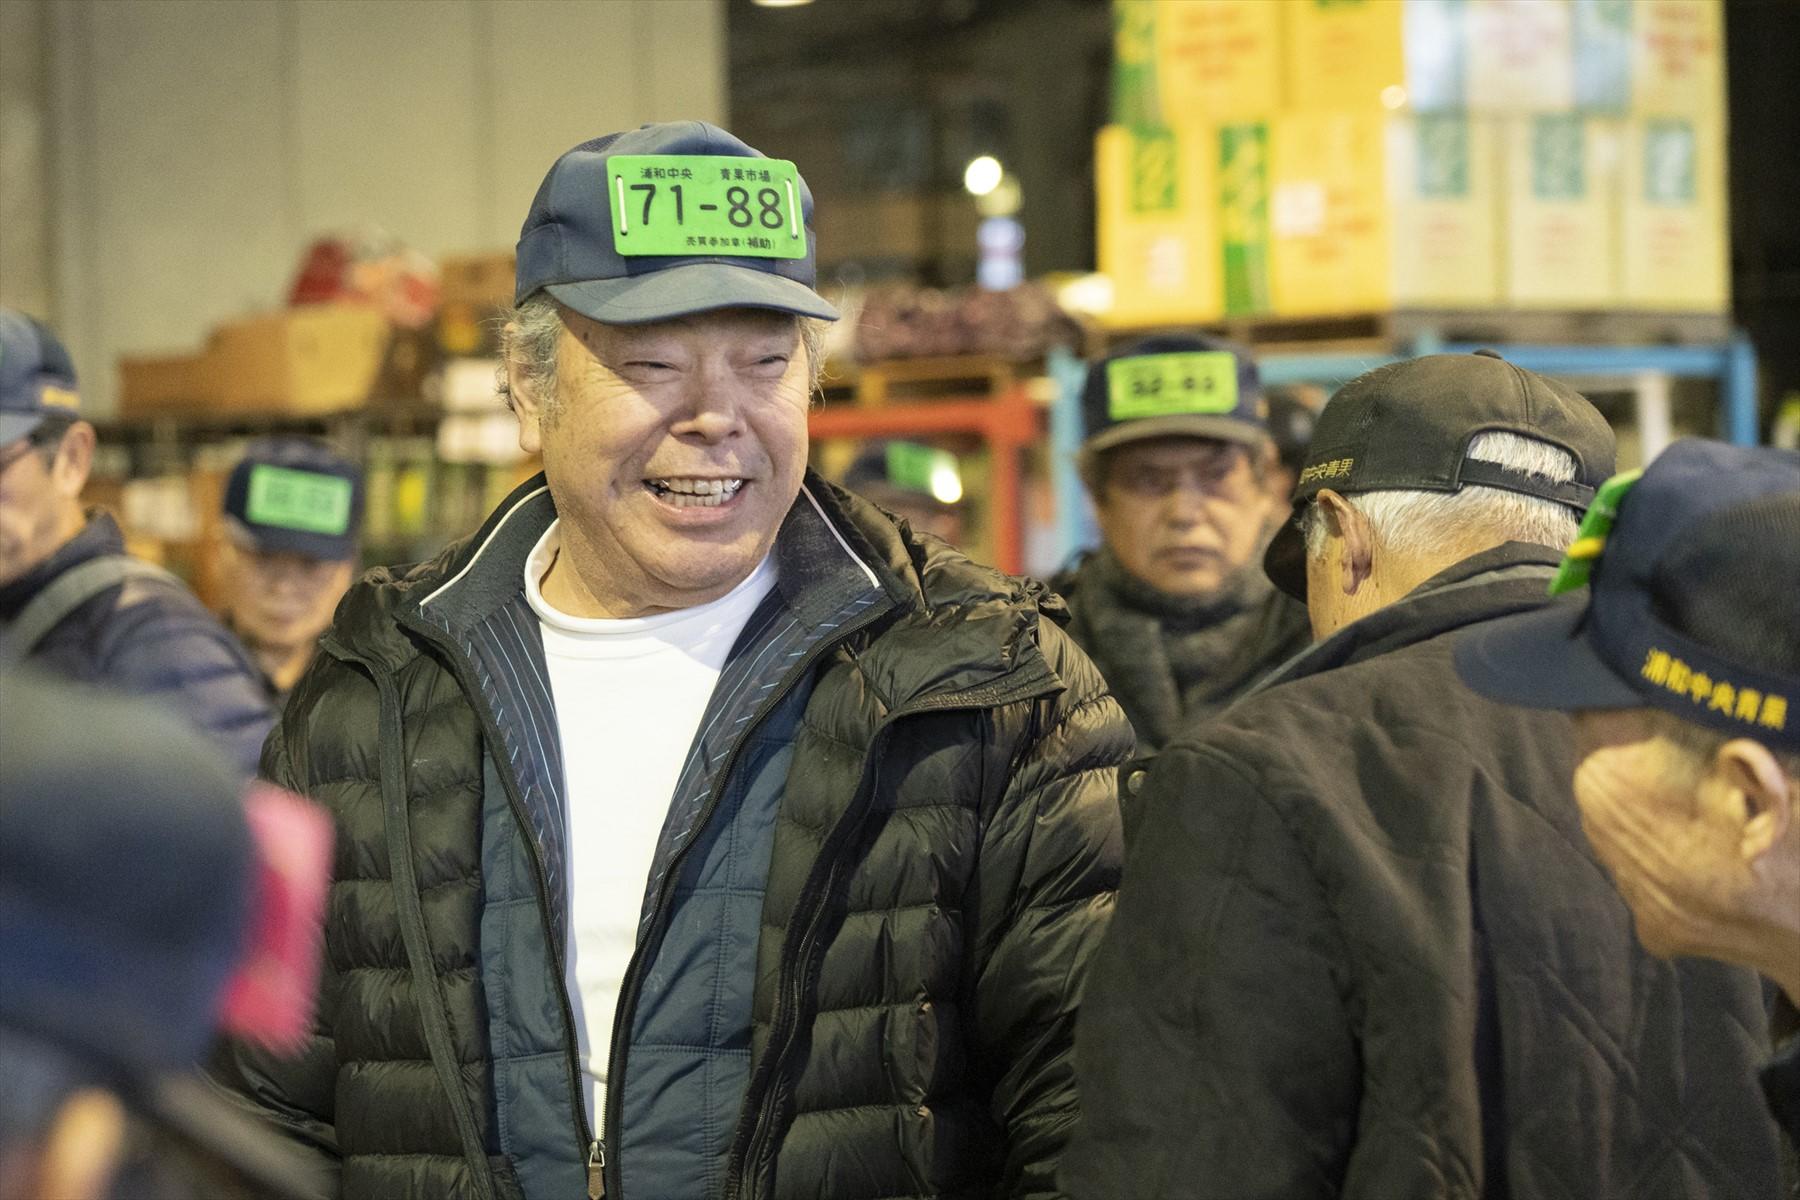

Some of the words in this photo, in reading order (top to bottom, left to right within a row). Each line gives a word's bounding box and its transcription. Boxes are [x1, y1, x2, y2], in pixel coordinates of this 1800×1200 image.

[640, 167, 693, 180] 浦和中央
[720, 168, 772, 183] 青果市場
[629, 183, 783, 229] 71-88
